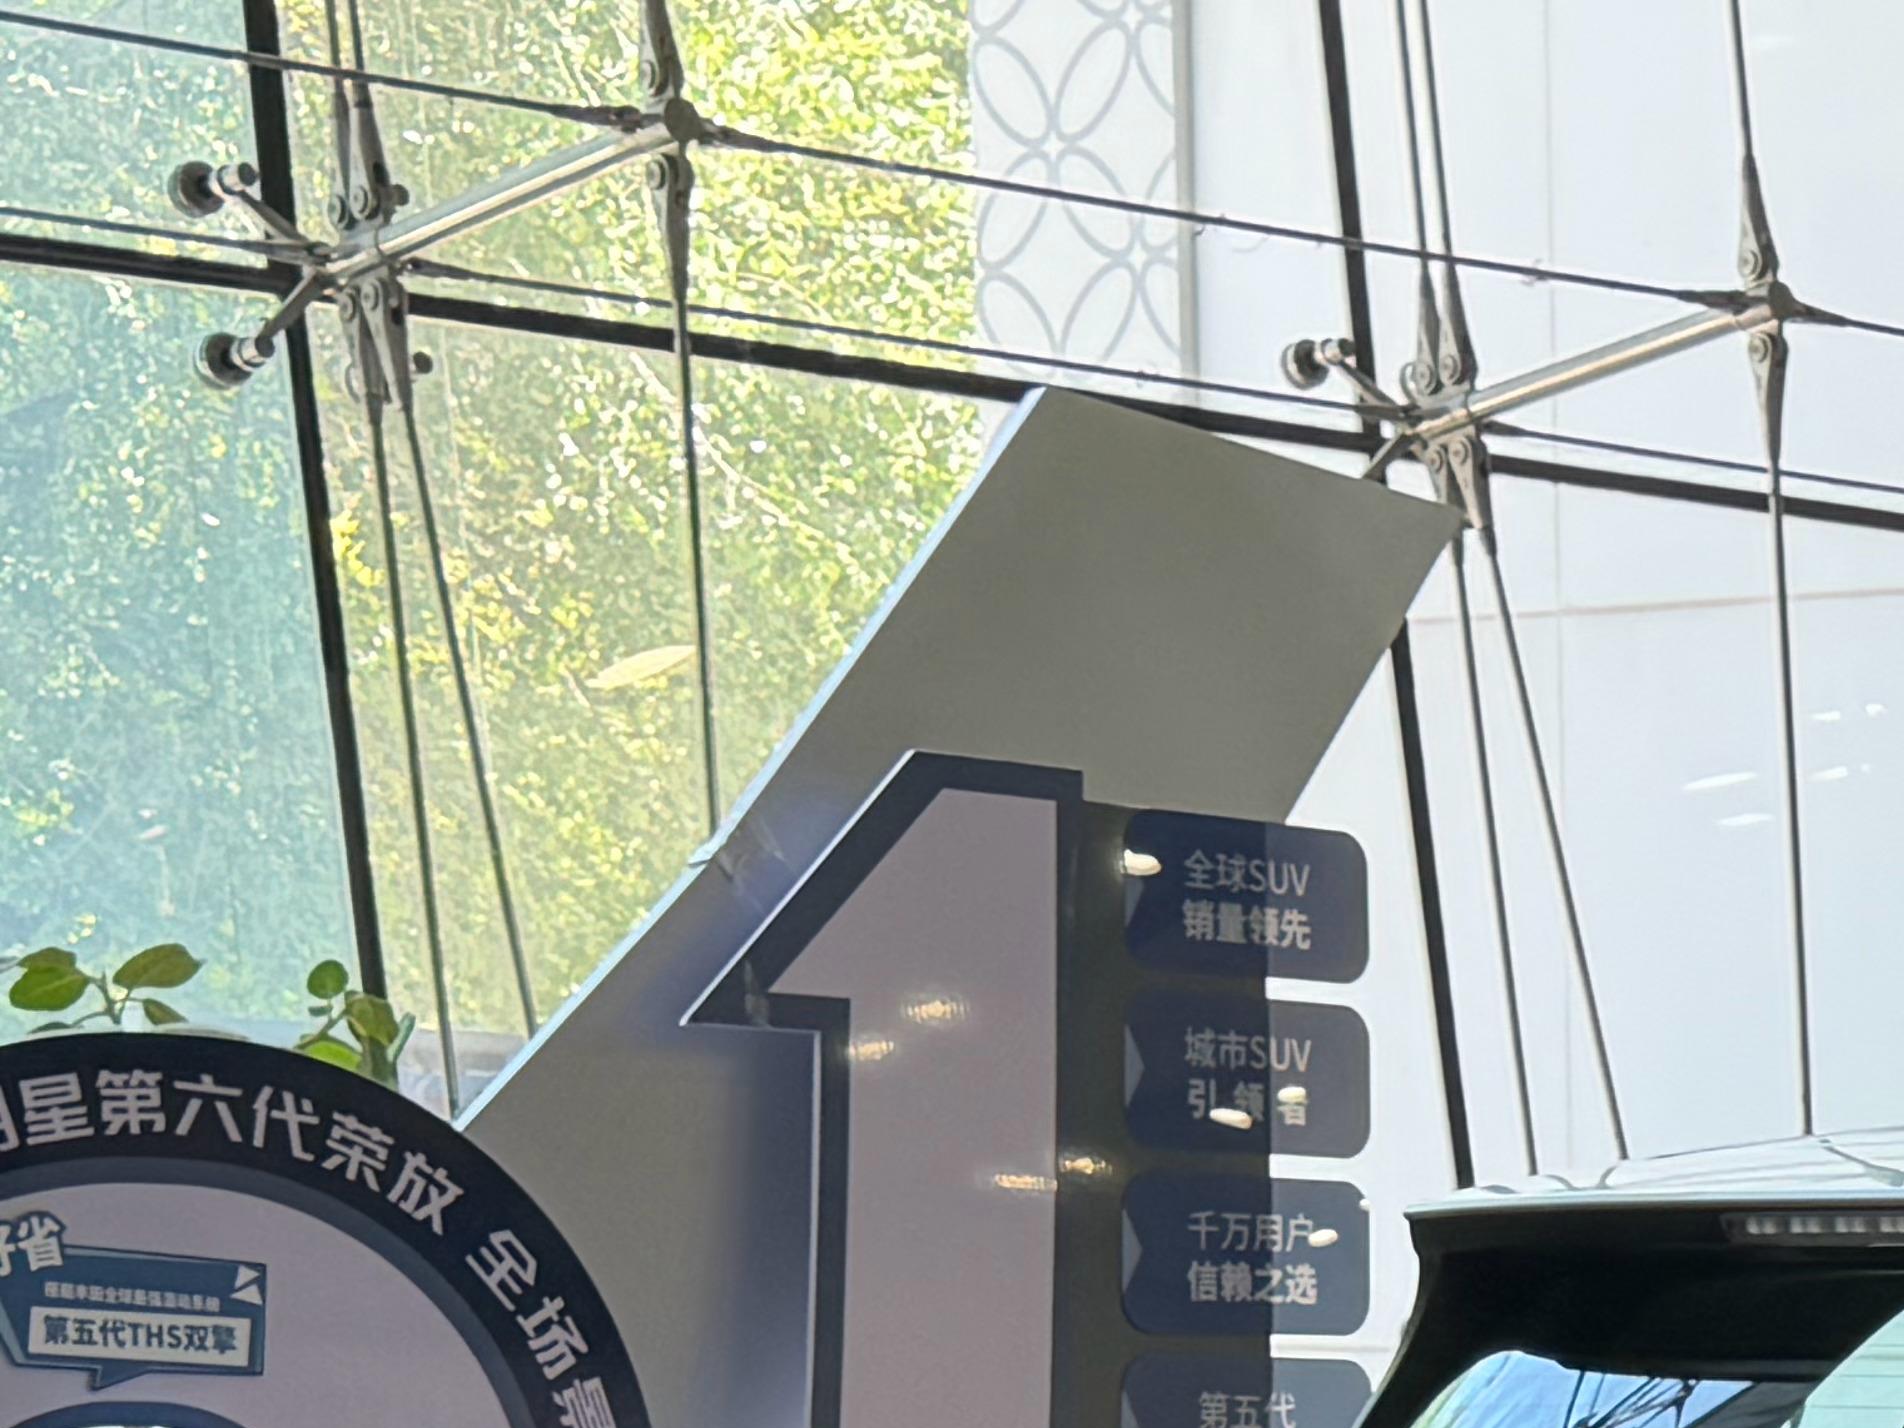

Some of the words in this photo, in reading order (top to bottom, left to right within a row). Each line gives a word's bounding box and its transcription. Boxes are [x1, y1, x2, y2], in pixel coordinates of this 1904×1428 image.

[1184, 849, 1311, 897] 全球SUV
[1181, 899, 1312, 951] 销量领先
[1183, 1025, 1312, 1074] 城市SUV
[1187, 1212, 1316, 1253] 千万用户
[1186, 1260, 1318, 1304] 信赖之选
[42, 1313, 239, 1356] 第五代THS双擎
